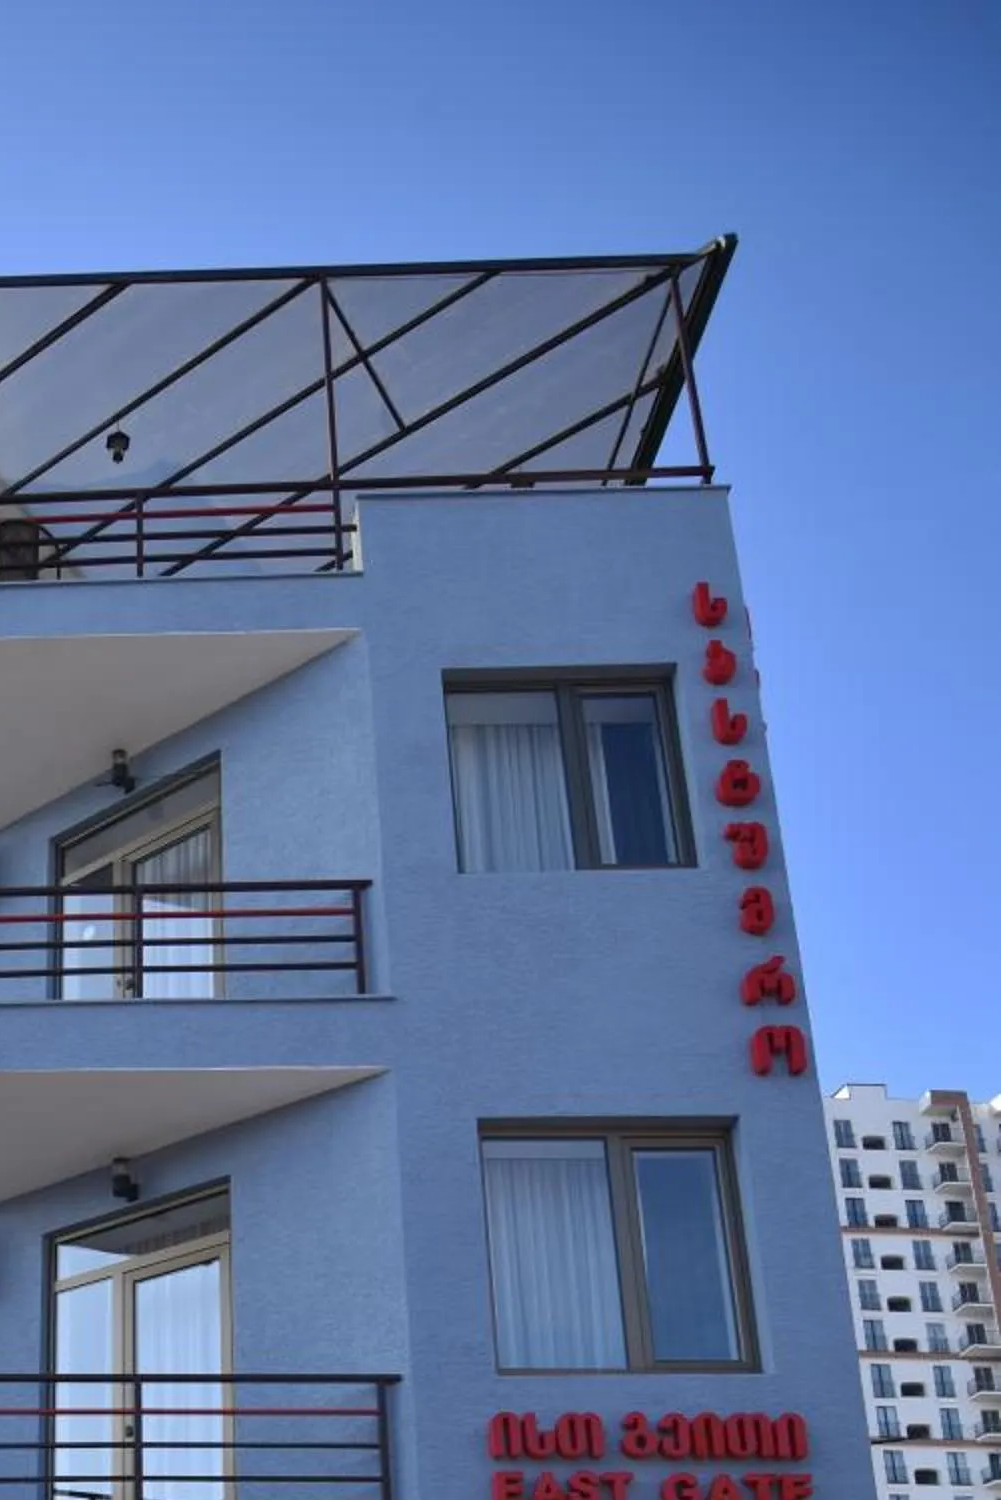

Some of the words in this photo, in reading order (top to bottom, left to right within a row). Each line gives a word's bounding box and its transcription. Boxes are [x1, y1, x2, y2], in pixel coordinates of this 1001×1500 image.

[692, 581, 807, 1076] სასტუმრო
[488, 1411, 605, 1461] ისთ
[620, 1411, 811, 1462] გეითი
